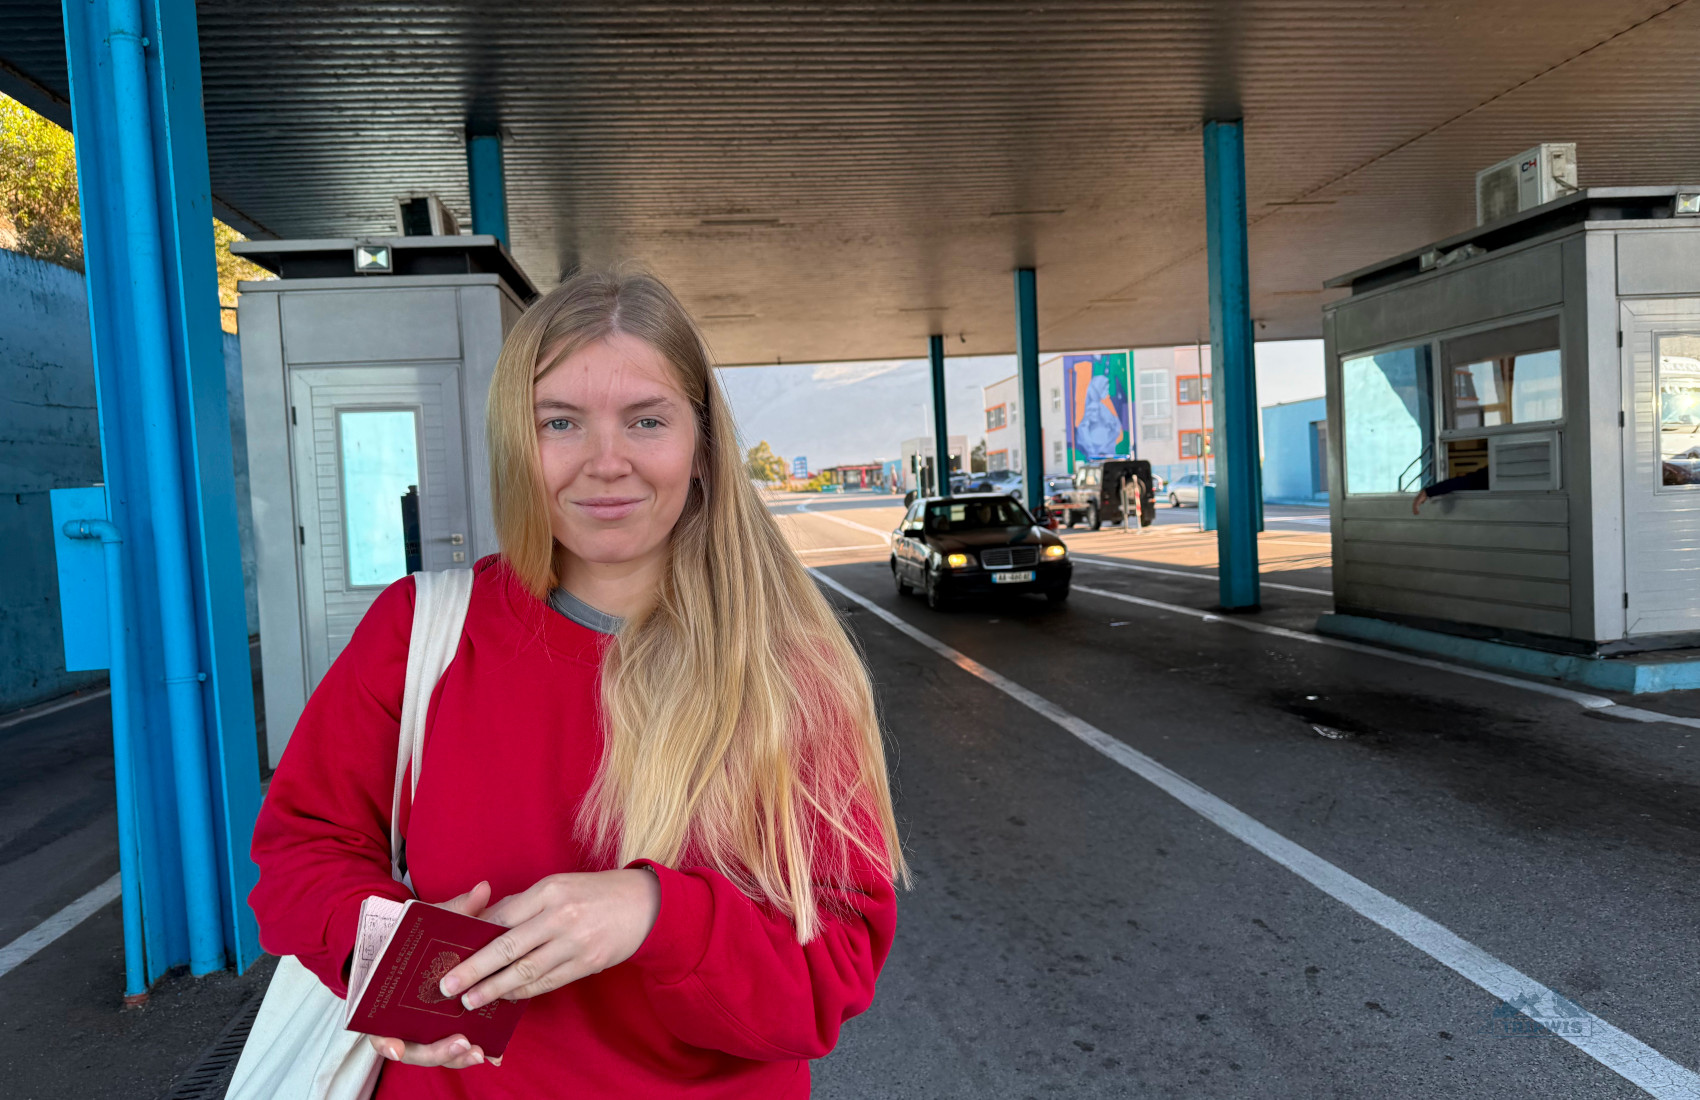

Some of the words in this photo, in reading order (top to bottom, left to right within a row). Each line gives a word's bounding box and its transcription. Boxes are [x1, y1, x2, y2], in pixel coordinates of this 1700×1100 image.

[368, 964, 398, 1018] РОССИЙСКАЯ
[380, 976, 401, 1009] RUSSIAN
[398, 929, 425, 975] FEDERATION
